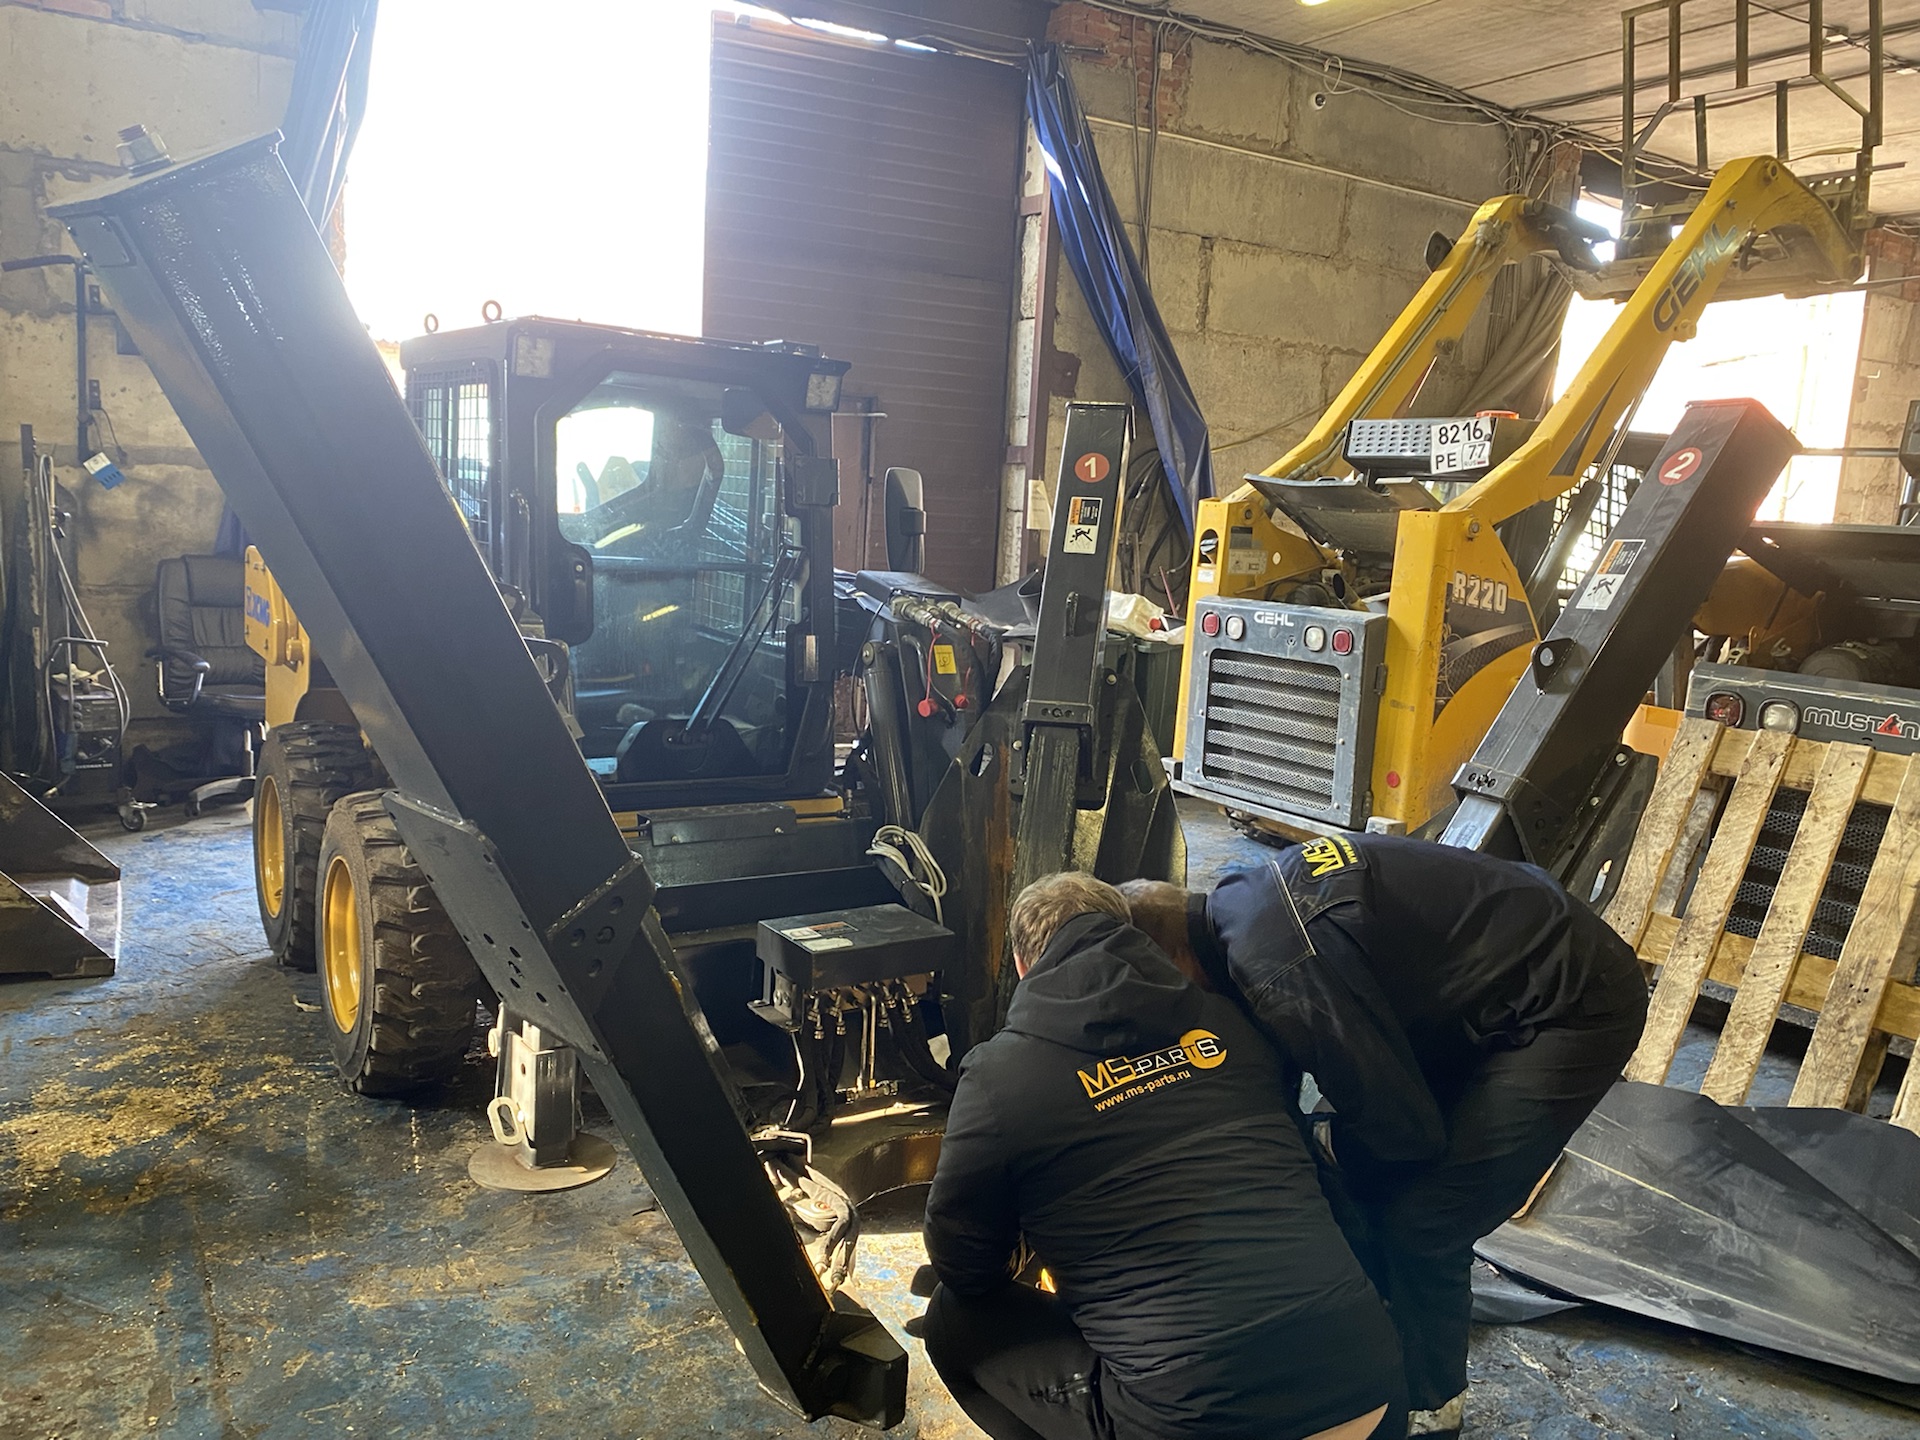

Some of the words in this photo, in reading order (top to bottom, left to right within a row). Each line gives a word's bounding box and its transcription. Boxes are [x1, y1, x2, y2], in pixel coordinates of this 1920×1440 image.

[1653, 222, 1738, 333] GEHL
[1438, 420, 1483, 445] 8216
[1435, 452, 1457, 470] PE
[1468, 443, 1486, 460] 77
[1084, 456, 1097, 479] 1
[1664, 451, 1696, 480] 2
[1452, 570, 1508, 615] R220
[1253, 611, 1295, 627] GEHL
[1094, 1069, 1192, 1112] www.ms-parts.ru
